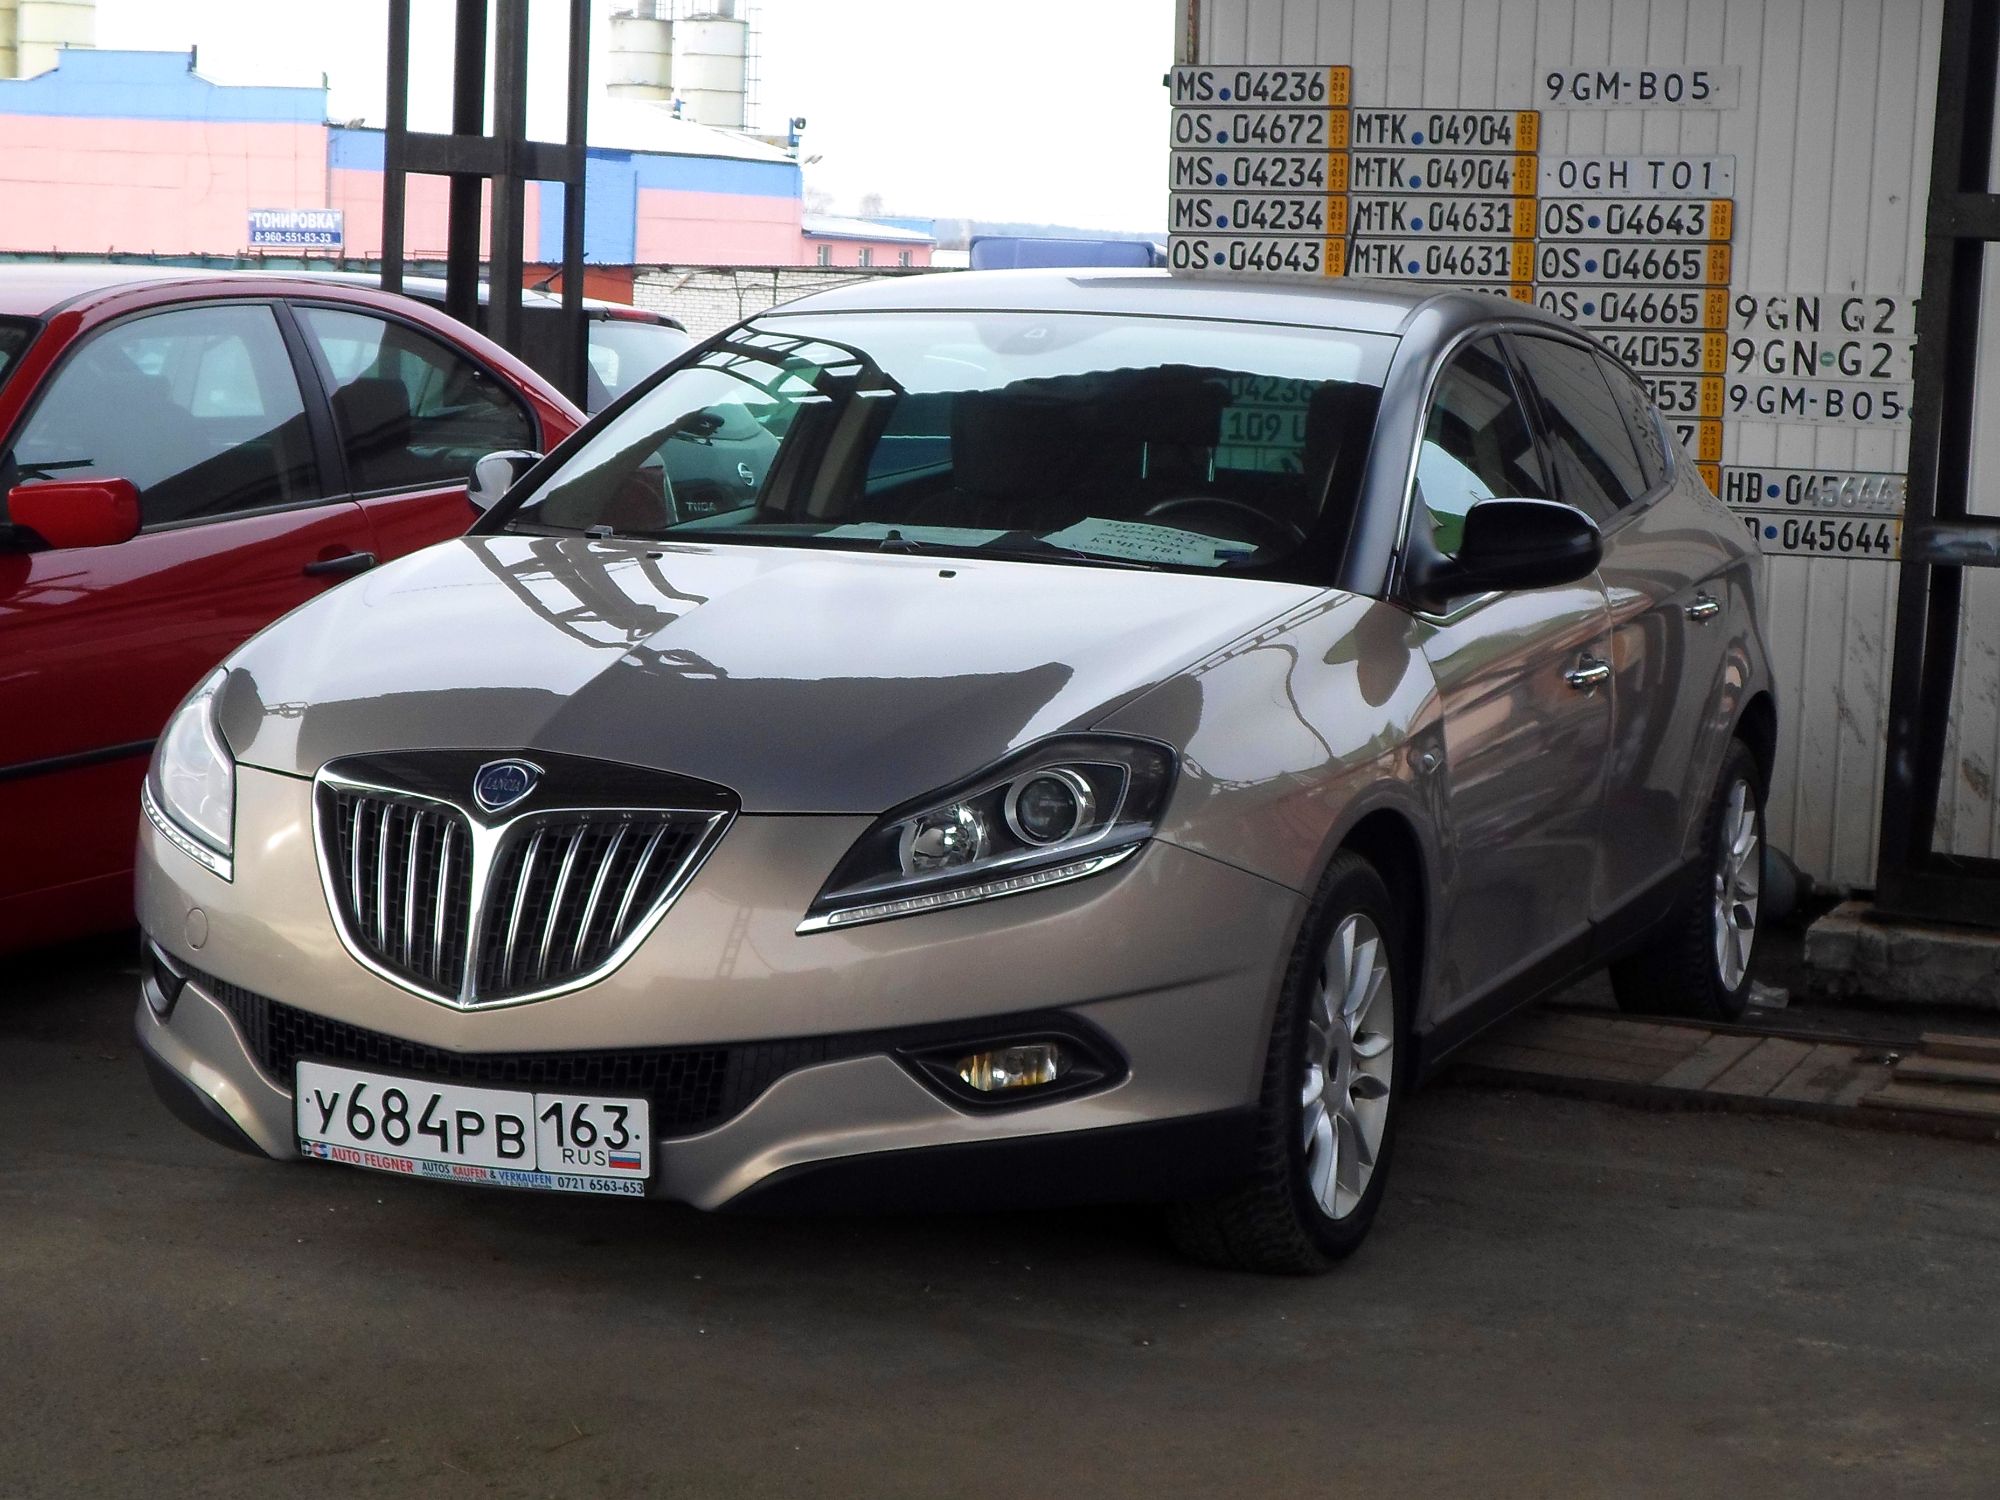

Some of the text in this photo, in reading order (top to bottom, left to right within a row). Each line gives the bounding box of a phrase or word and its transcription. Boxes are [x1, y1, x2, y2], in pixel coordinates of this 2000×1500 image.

[1177, 71, 1325, 101] MS 04236
[1176, 113, 1323, 144] OS 04672
[1356, 113, 1511, 145] MTK 04904
[1176, 156, 1323, 187] MS 04234
[1354, 157, 1510, 189] MTK 04904
[1175, 198, 1323, 230] MS 04234
[1356, 201, 1511, 232] MTK 04631
[1544, 203, 1705, 235] OS 04643
[1172, 240, 1320, 272] OS 04643
[1354, 244, 1510, 276] MTK 04631
[1541, 247, 1701, 280] OS 04665
[1600, 292, 1699, 324] 04665
[1735, 294, 1820, 332] 9GN
[1732, 338, 1817, 376] 9GN
[1783, 519, 1891, 554] 045644
[540, 1102, 630, 1150] 163
[331, 1147, 414, 1173] AUTO FELGNER
[422, 1161, 450, 1174] AUTOS
[453, 1166, 487, 1178] KAUFEN
[490, 1169, 497, 1179] &
[499, 1171, 551, 1185] VERKAUFEN
[562, 1148, 606, 1166] RUS
[558, 1177, 584, 1190] 0721
[589, 1179, 644, 1194] 6563-653
